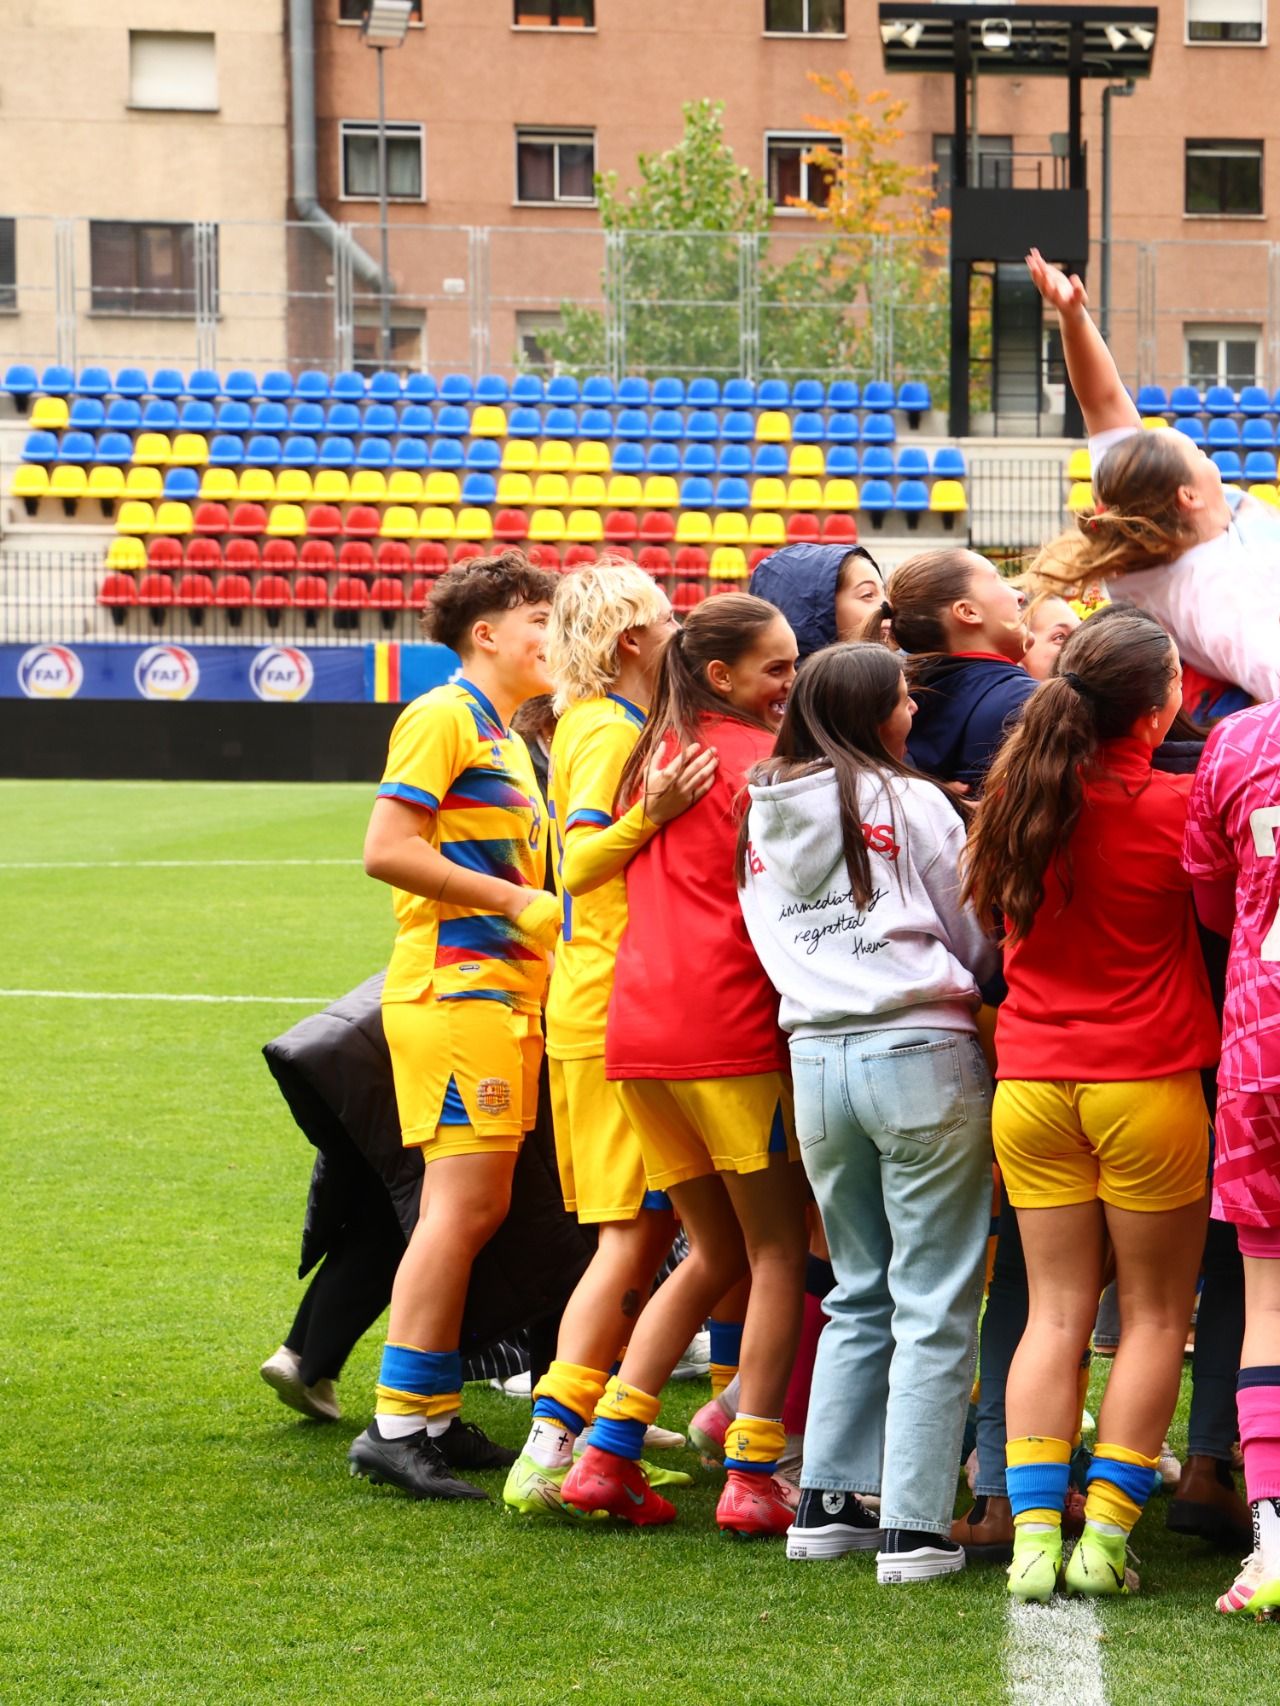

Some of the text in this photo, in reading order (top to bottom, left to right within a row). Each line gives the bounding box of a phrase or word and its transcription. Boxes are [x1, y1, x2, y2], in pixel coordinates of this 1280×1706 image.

[35, 668, 63, 682] FAF
[151, 668, 179, 682] FAF
[266, 669, 295, 683] FAF
[778, 888, 890, 922] immediaty
[794, 911, 867, 955] regretted
[1253, 1521, 1261, 1551] NEO
